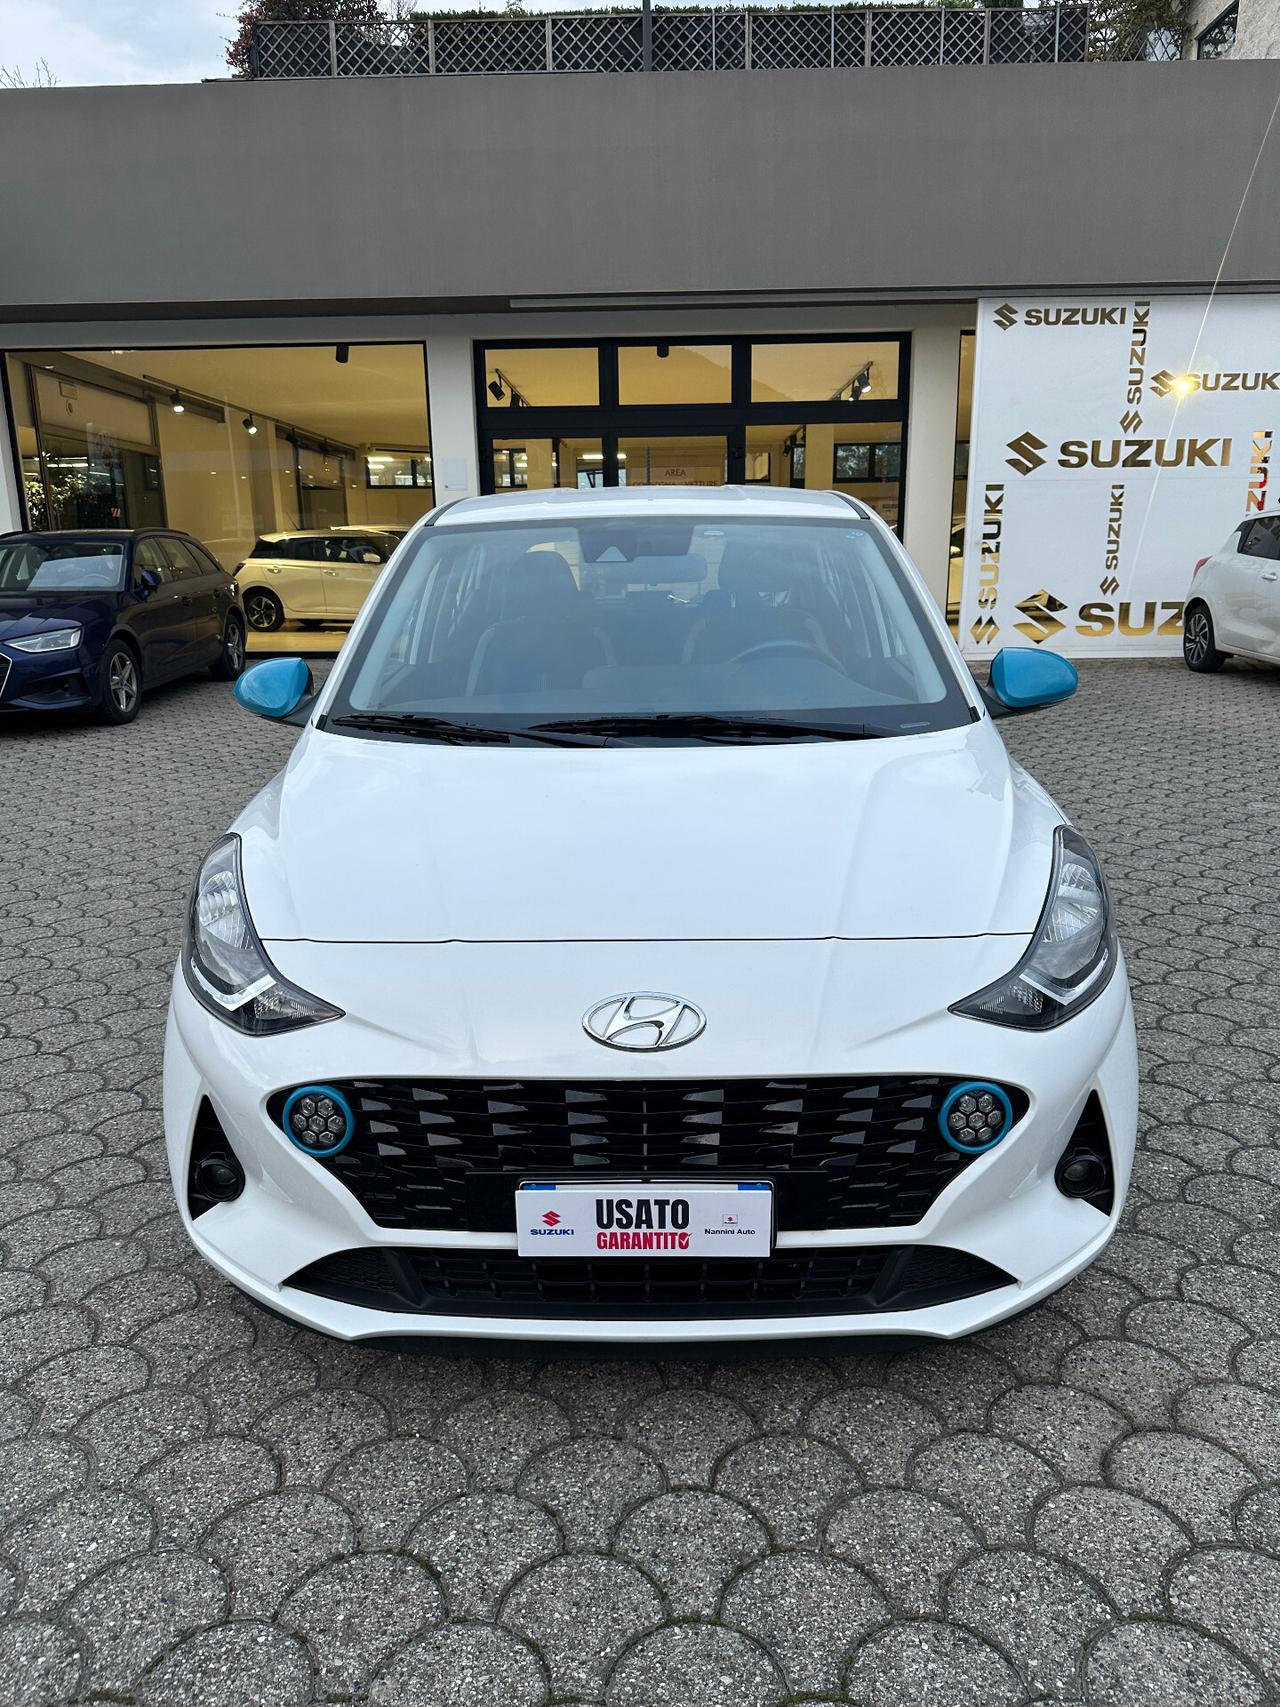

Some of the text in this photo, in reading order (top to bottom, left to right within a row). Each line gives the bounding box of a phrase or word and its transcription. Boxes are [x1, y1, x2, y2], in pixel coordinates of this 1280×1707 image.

[1023, 307, 1127, 326] SUZUKI
[1127, 301, 1151, 405] SUZUKI
[1185, 373, 1280, 391] SUZUK
[1057, 438, 1233, 469] SUZUKI
[664, 468, 687, 477] AREA
[1245, 431, 1273, 515] ZUKI
[1105, 484, 1125, 571] SUZUKI
[978, 484, 1005, 610] SUZUKI
[1075, 601, 1185, 637] SUZ
[595, 1198, 690, 1230] USATO
[530, 1228, 575, 1236] SUZUKI
[596, 1231, 692, 1250] GARANTITO
